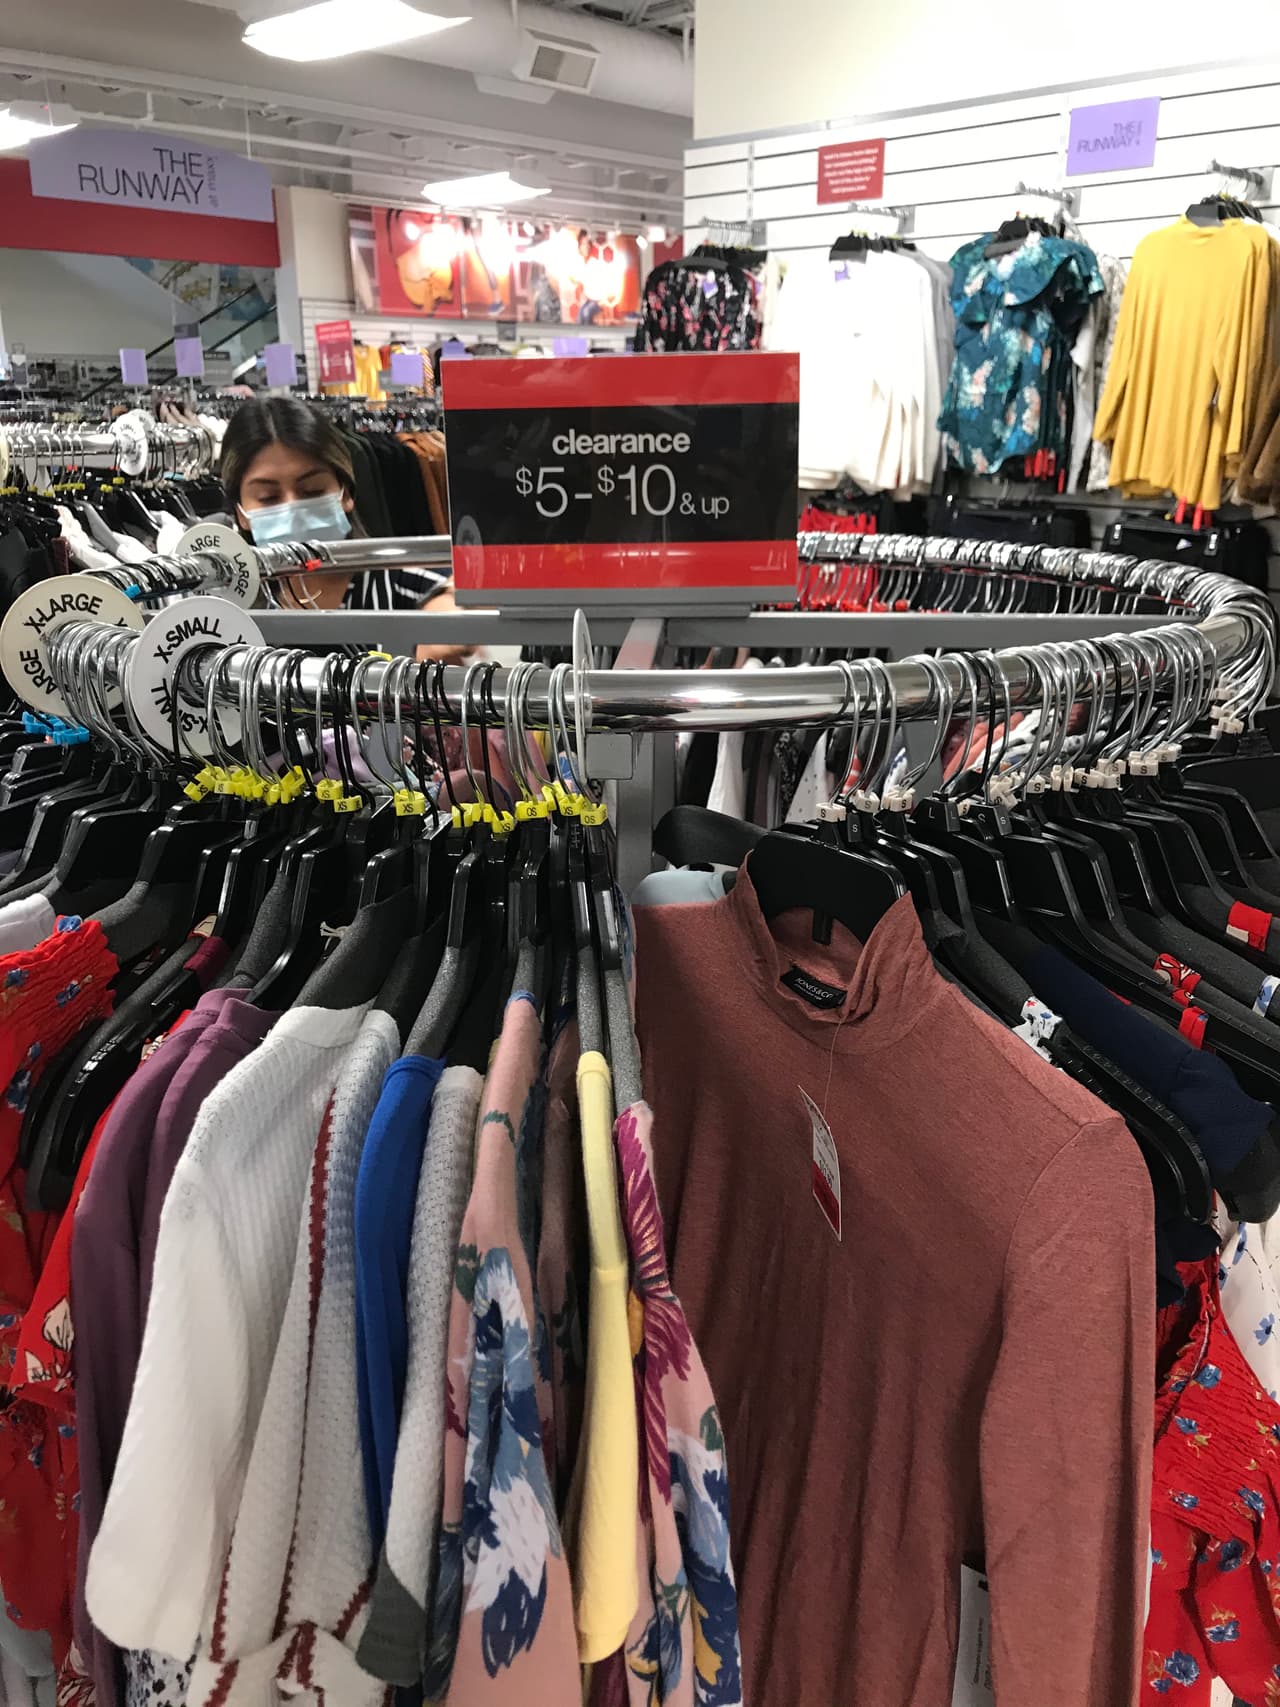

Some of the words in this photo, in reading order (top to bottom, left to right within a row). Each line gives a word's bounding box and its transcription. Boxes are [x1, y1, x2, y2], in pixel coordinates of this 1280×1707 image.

[1113, 120, 1138, 138] THE
[1077, 135, 1134, 153] RUNWAY
[153, 147, 204, 178] THE
[78, 163, 204, 205] RUNWAY
[552, 428, 691, 455] clearance
[679, 492, 696, 515] &
[701, 495, 730, 519] up
[190, 535, 221, 553] ARGE
[233, 552, 250, 599] LARGE
[23, 593, 103, 634] X-LARGE
[153, 616, 222, 664] X-SMALL
[1140, 765, 1147, 775] S
[1034, 782, 1041, 792] S
[1081, 775, 1088, 785] S
[338, 801, 348, 810] XS
[403, 803, 414, 813] XS
[865, 800, 872, 809] S
[901, 799, 907, 809] S
[820, 808, 826, 818] S
[1000, 816, 1006, 825] S
[852, 824, 858, 833] S
